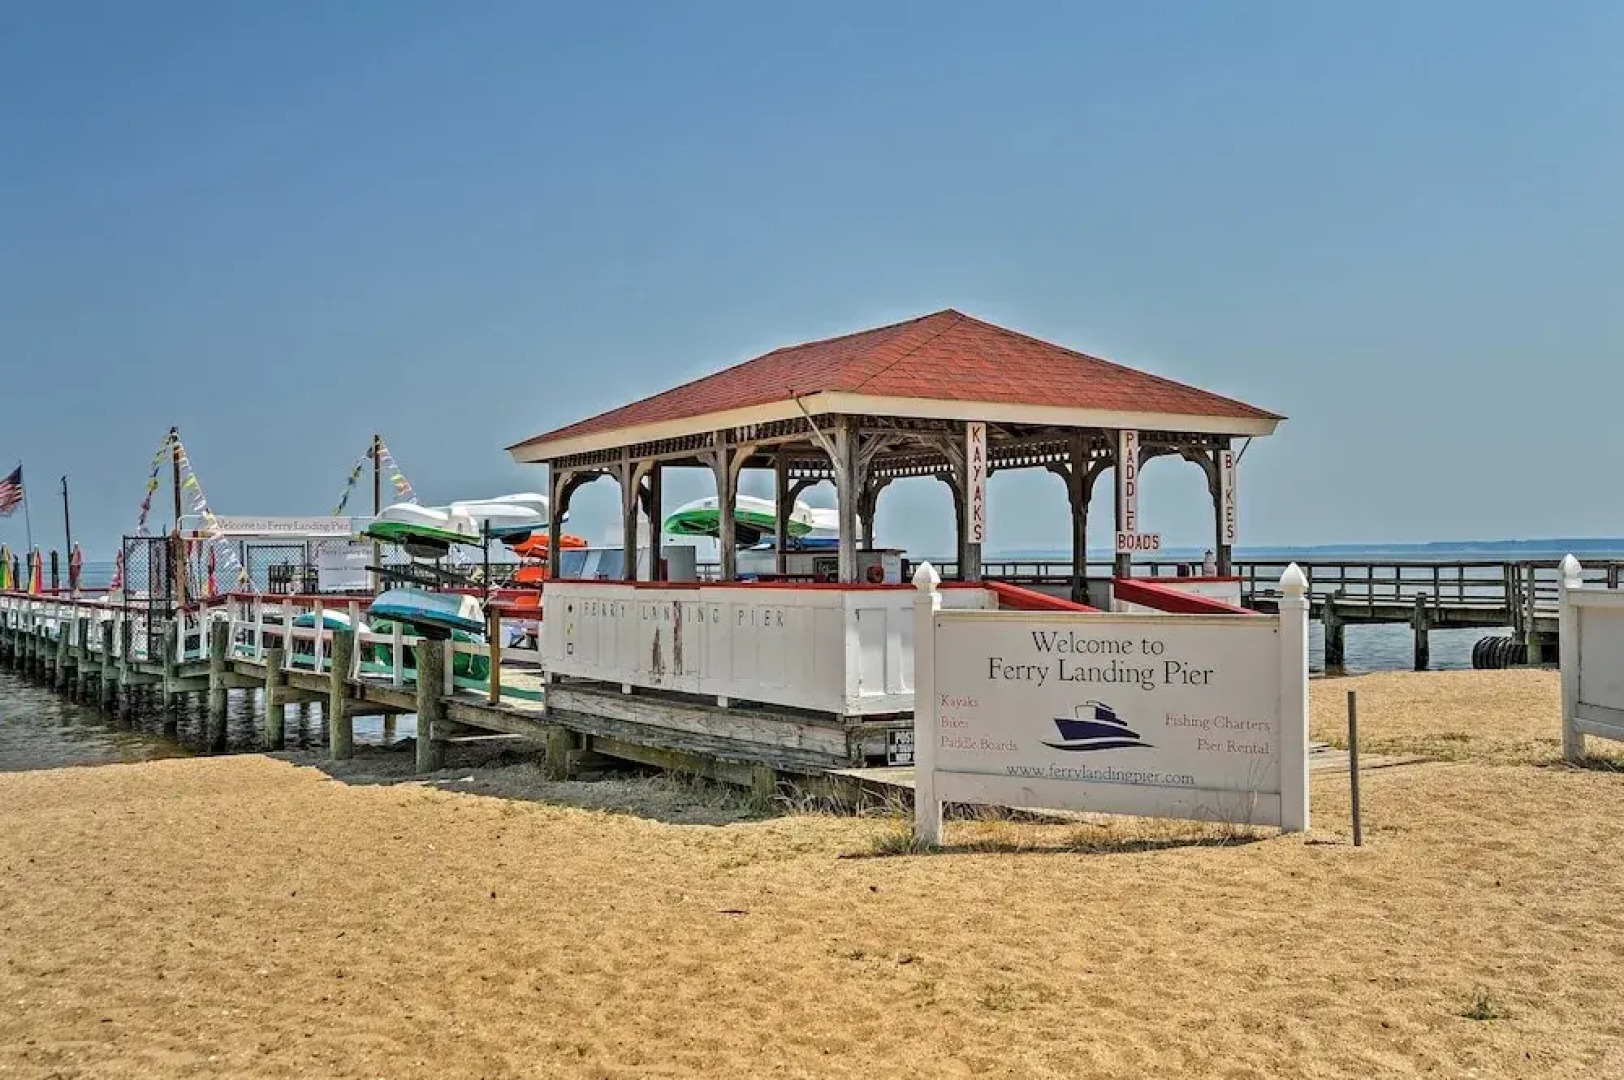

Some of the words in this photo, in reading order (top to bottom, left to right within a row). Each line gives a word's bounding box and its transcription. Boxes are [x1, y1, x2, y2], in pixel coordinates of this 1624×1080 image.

[971, 425, 983, 541] KAYAKS
[1125, 431, 1136, 531] PADDLE
[1225, 454, 1235, 539] BIKES
[738, 609, 784, 627] PIER
[1031, 631, 1133, 655] Welcome
[1142, 637, 1165, 655] to
[988, 657, 1049, 687] Ferry
[1057, 659, 1155, 691] Landing
[1163, 660, 1214, 686] Pier
[941, 694, 979, 710] Kayaks
[1165, 713, 1211, 731] Fishing
[1214, 715, 1271, 731] Charters
[941, 735, 977, 750] Paddle
[980, 738, 1018, 751] Boards
[1198, 738, 1222, 751] Pier
[1227, 740, 1270, 755] Rental
[1006, 763, 1196, 786] www.ferrylandingpier.com
